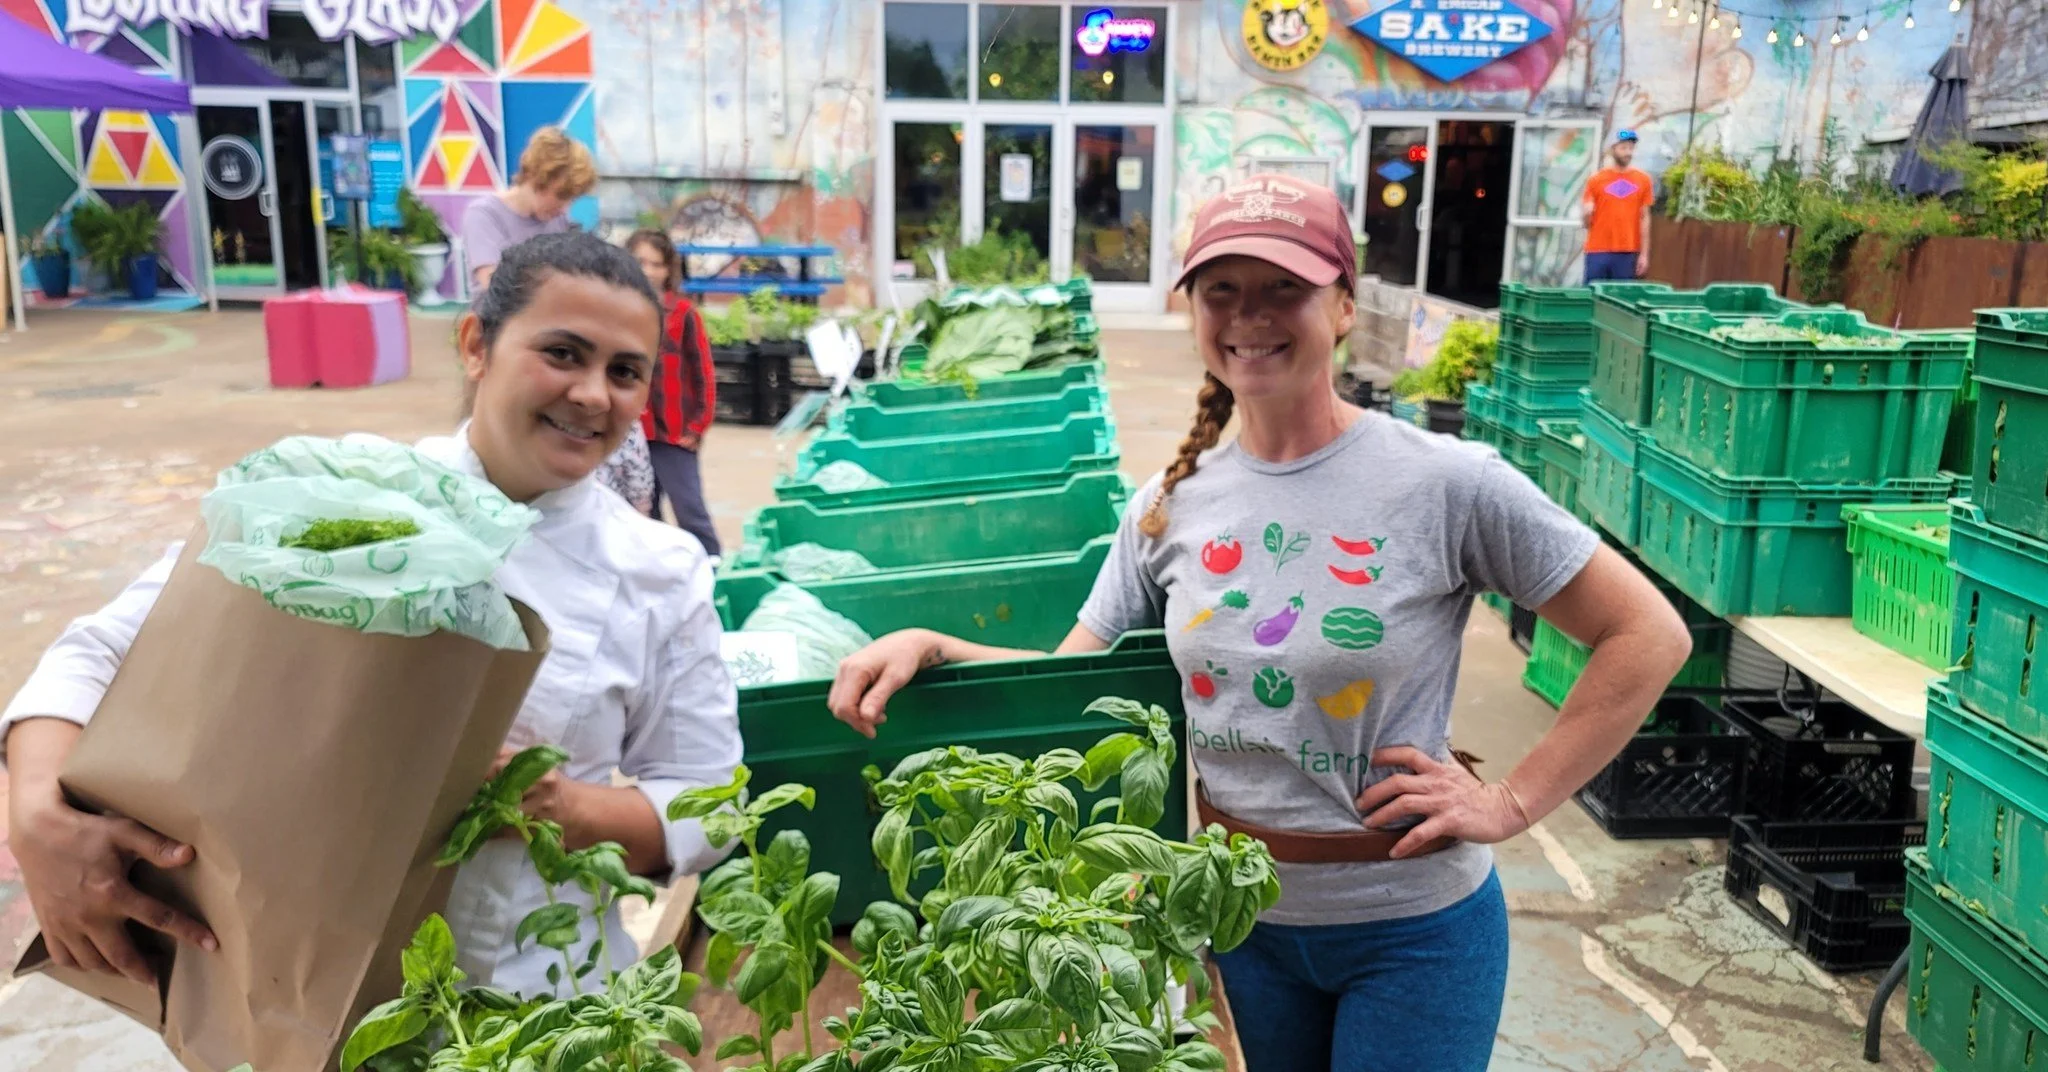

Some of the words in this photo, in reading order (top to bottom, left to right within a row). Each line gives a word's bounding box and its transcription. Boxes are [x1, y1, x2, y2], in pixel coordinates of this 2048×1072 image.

[1379, 10, 1531, 42] SAKE
[1403, 41, 1504, 58] BREWERY
[1298, 739, 1370, 775] farm
